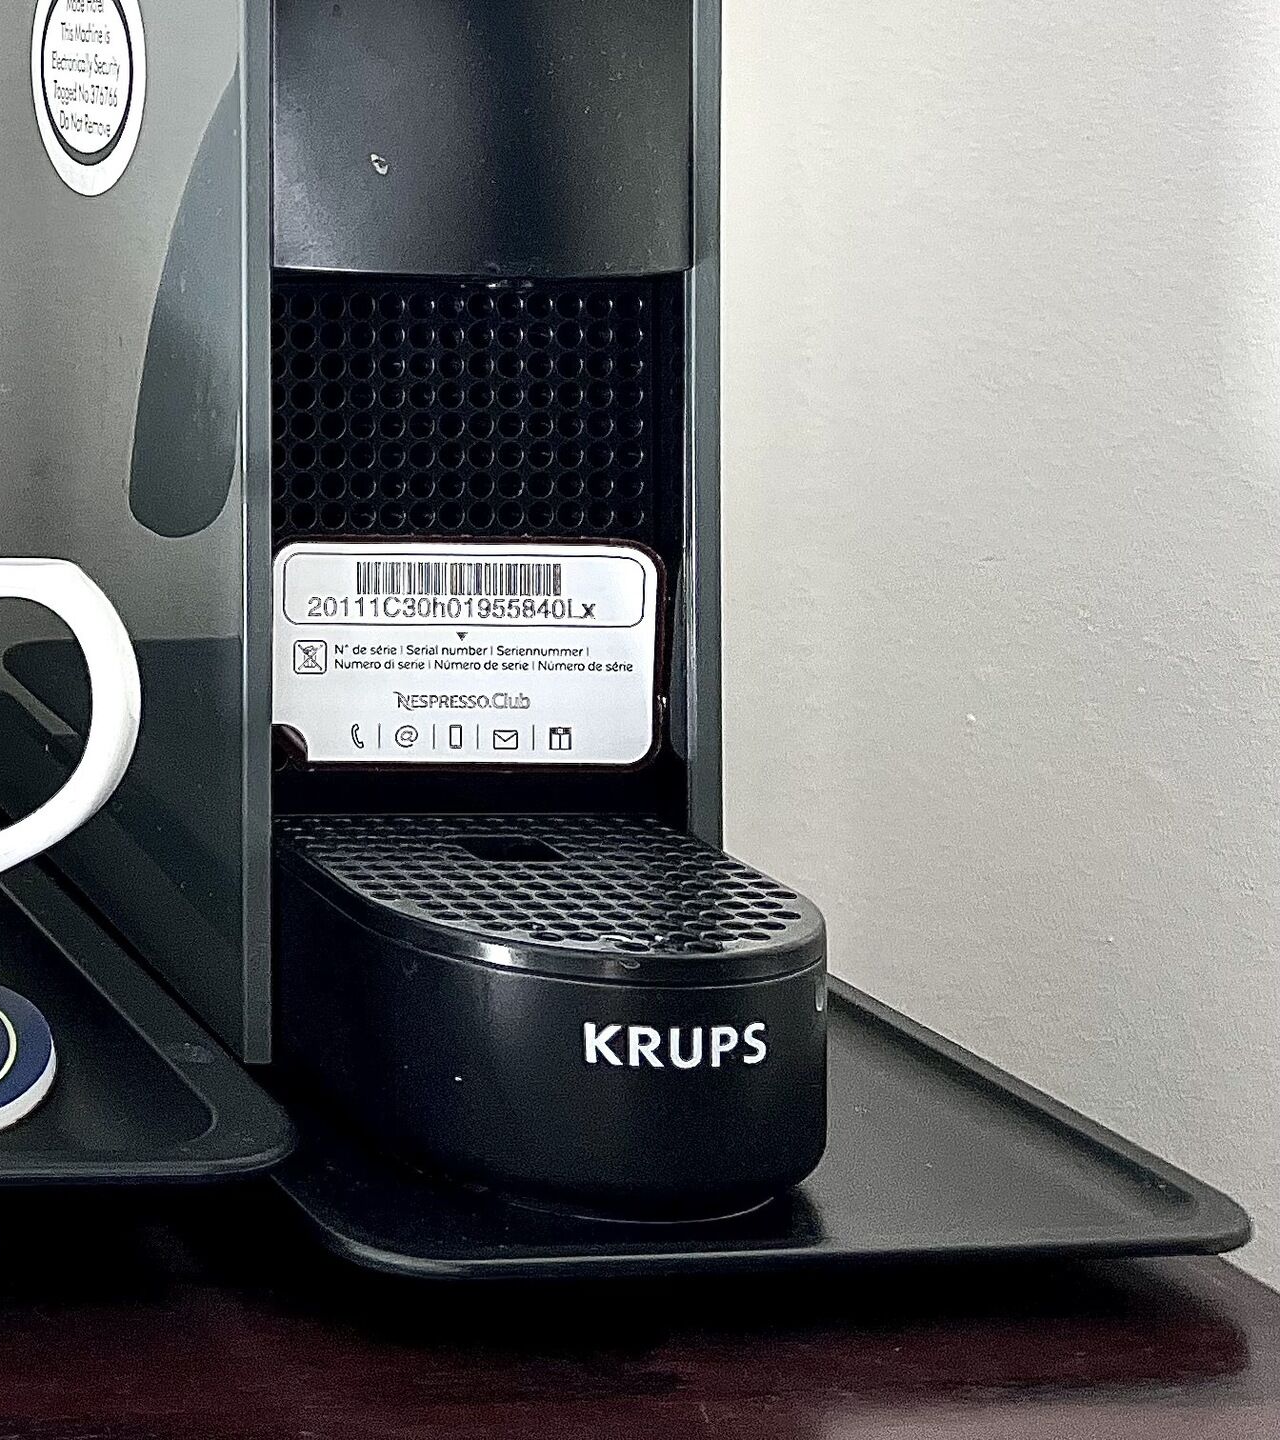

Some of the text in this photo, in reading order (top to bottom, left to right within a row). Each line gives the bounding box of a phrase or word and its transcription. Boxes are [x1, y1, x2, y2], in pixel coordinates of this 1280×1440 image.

[61, 21, 111, 45] This Machine is
[51, 50, 121, 82] Electronically Security
[53, 79, 77, 105] Tagged
[59, 109, 111, 138] Do Not Remove
[352, 644, 368, 656] de
[370, 644, 398, 656] série
[406, 644, 439, 656] Serial
[441, 644, 489, 657] number
[496, 645, 584, 657] Seriennummer
[334, 658, 382, 671] Numero
[383, 658, 395, 671] di
[433, 658, 481, 671] Número
[483, 659, 499, 671] de
[537, 660, 586, 672] Número
[587, 661, 603, 672] de
[605, 661, 634, 673] série
[583, 1021, 768, 1070] KRUPS
